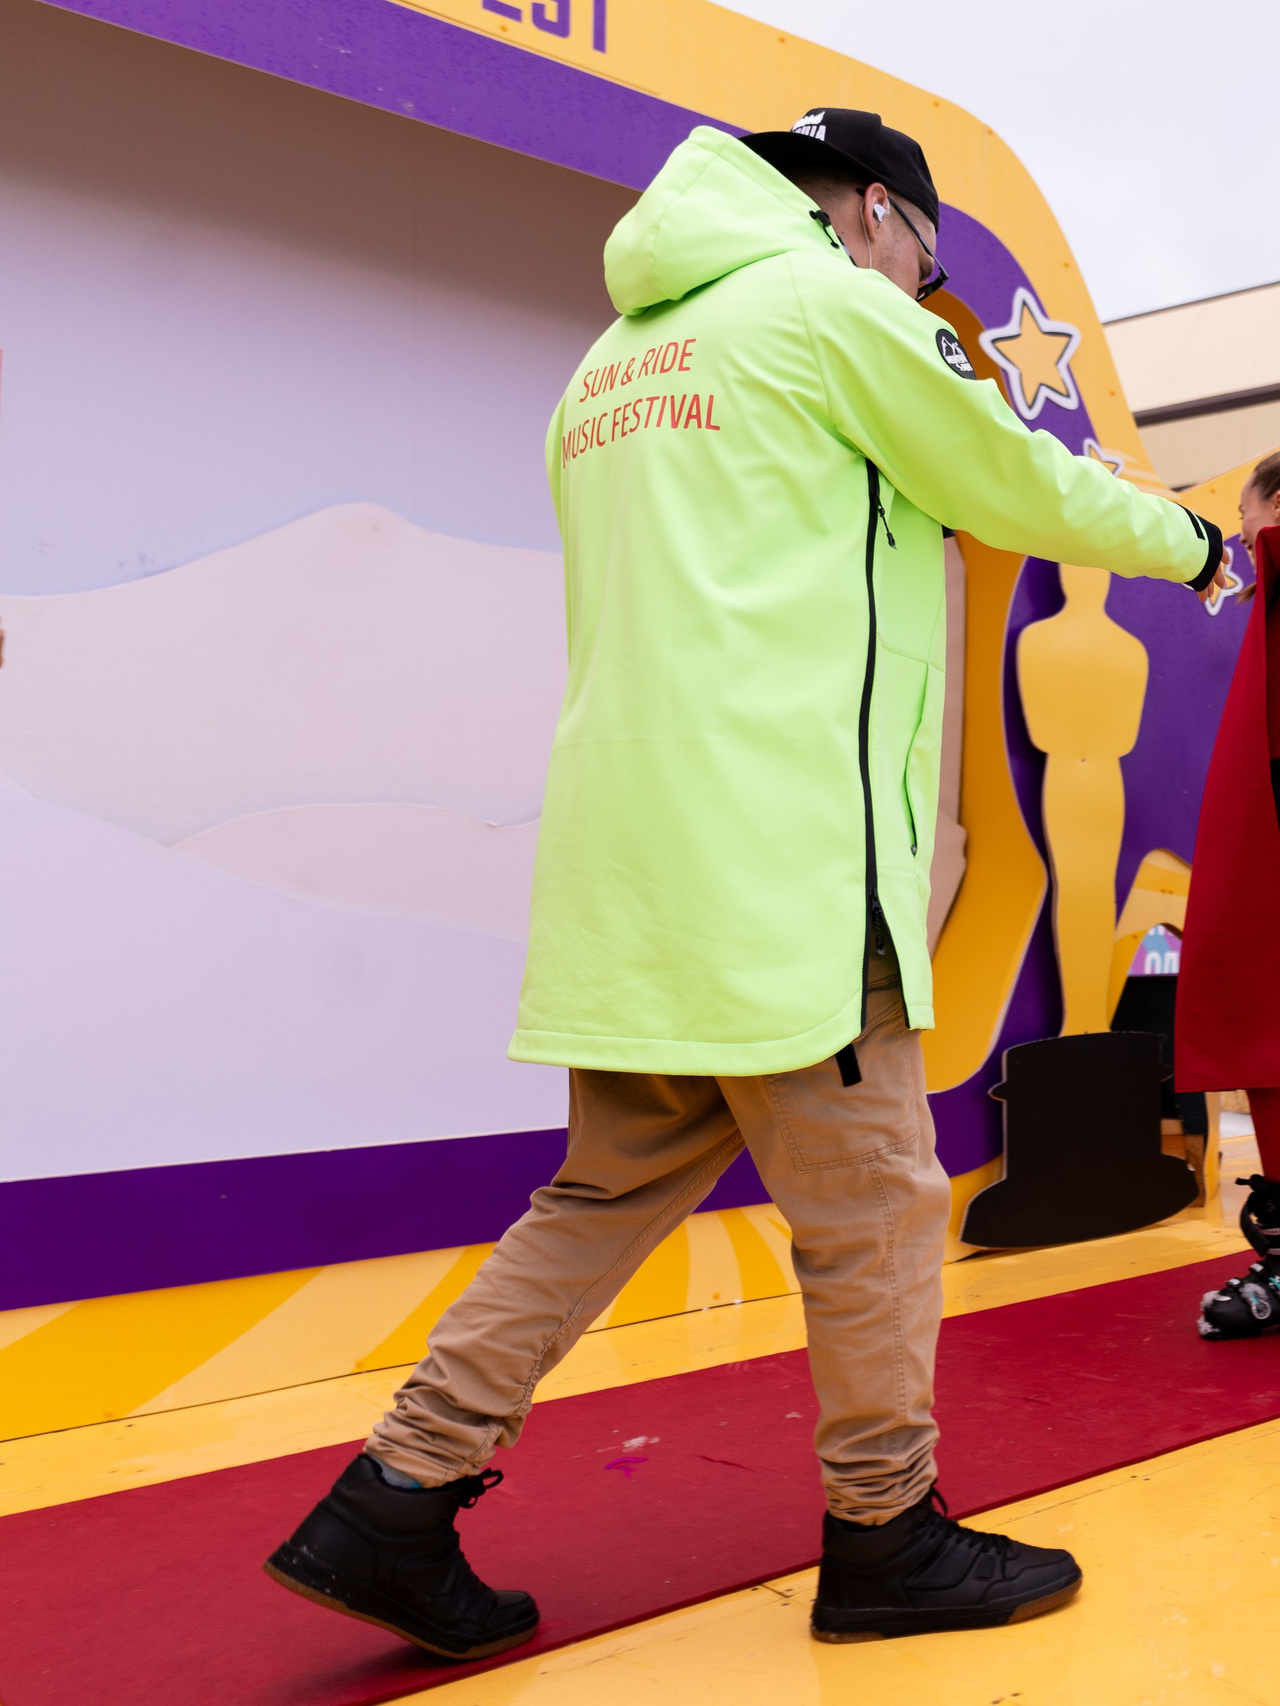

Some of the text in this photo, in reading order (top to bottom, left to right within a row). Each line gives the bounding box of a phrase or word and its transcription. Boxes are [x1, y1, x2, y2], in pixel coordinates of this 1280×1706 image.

[578, 338, 697, 403] SUN & RIDE
[562, 394, 721, 469] MUSIC FESTIVAL
